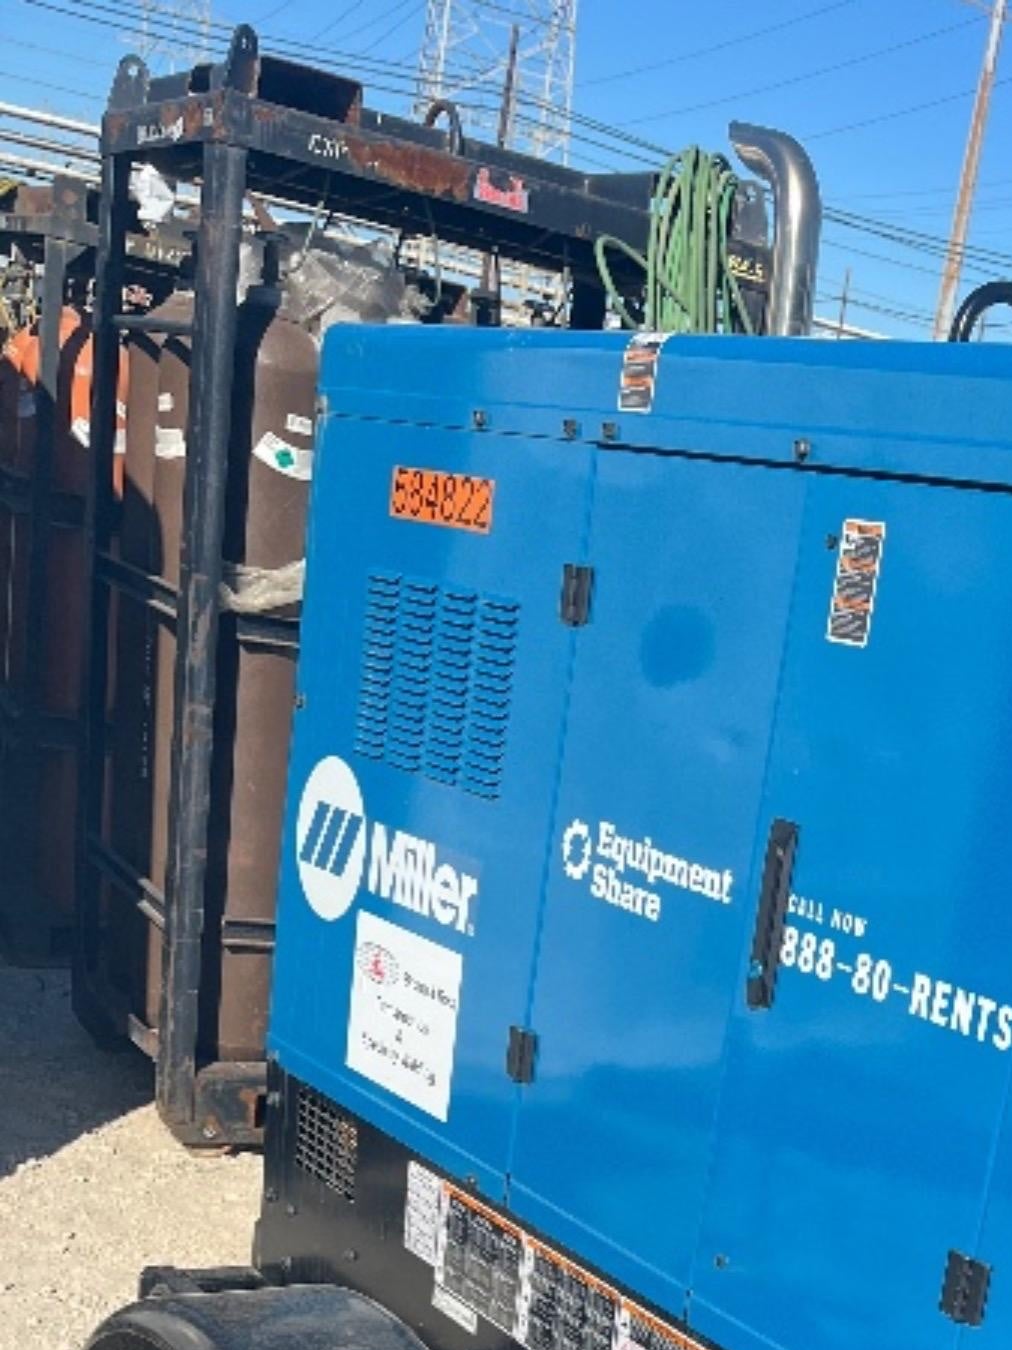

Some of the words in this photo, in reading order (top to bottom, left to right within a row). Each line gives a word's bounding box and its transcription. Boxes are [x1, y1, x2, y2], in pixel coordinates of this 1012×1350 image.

[392, 467, 490, 529] 584822
[367, 821, 478, 934] Miller
[590, 863, 662, 922] Share
[596, 820, 733, 904] Equipment
[787, 893, 824, 925] CALL
[829, 908, 868, 937] NOW
